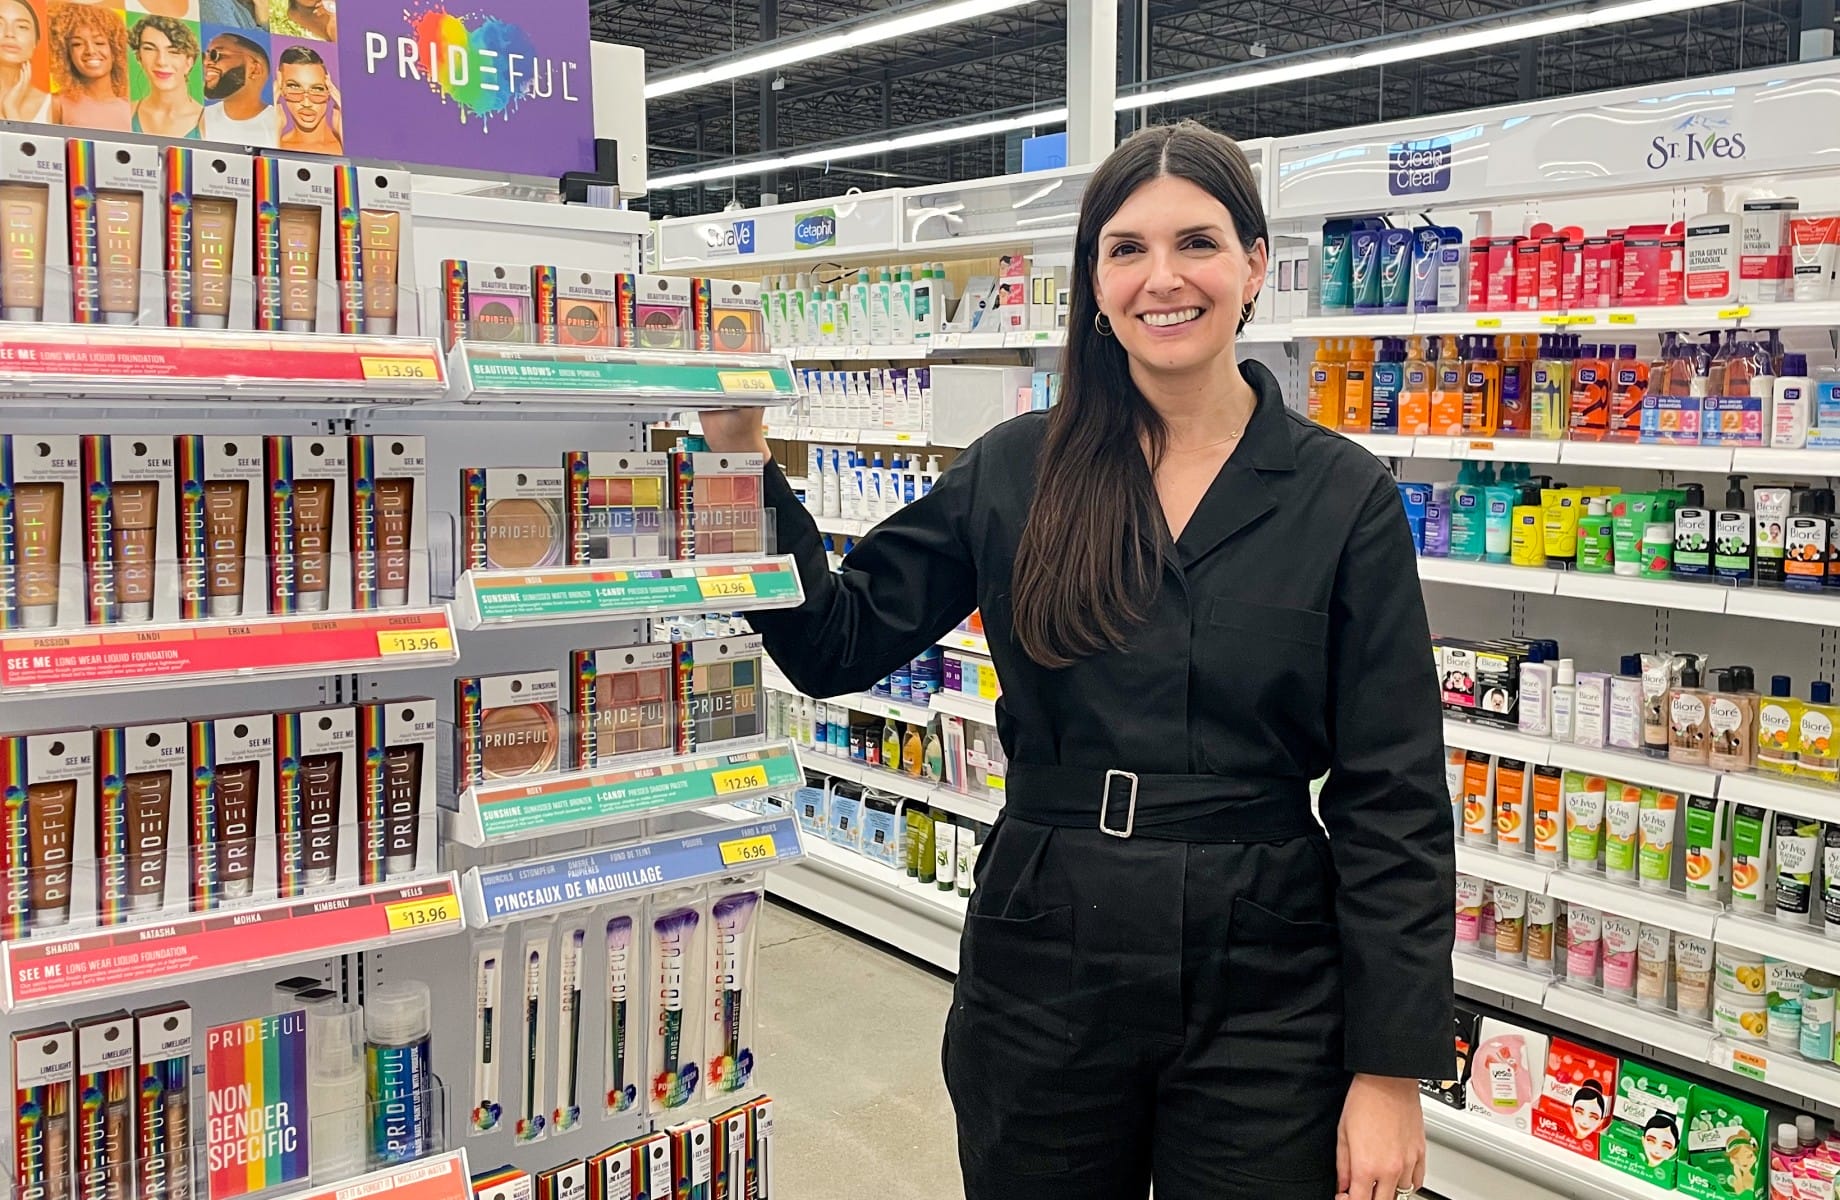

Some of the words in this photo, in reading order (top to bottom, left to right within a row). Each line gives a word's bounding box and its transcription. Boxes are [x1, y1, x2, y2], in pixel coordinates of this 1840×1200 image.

[1685, 133, 1746, 162] Ives
[1397, 150, 1442, 168] Clean
[1397, 168, 1437, 188] Clear
[797, 219, 833, 240] Cetaphil
[1689, 249, 1705, 258] ULTRA
[1707, 248, 1728, 256] GENTLE
[1689, 256, 1721, 266] ULTRADOUX
[77, 214, 99, 312] PRIDEFUL
[169, 217, 192, 316] PRIDEFUL
[259, 220, 281, 320] PRIDEFUL
[378, 362, 424, 379] $13.96
[473, 364, 519, 376] BEAUTIFUL
[52, 459, 65, 468] SEE
[67, 459, 78, 468] ME
[148, 459, 160, 467] SEE
[162, 458, 172, 467] ME
[238, 458, 250, 467] SEE
[252, 458, 261, 466] ME
[590, 511, 660, 528] PRIDEFUL
[692, 510, 757, 526] PRIDEFUL
[1678, 517, 1705, 529] Bioré
[212, 484, 236, 588] PRIDEFUL
[299, 485, 321, 584] PRIDEFUL
[382, 486, 404, 581] PRIDEFUL
[490, 525, 555, 539] PRIDEFUL
[1790, 526, 1821, 540] Bioré
[121, 489, 147, 595] PRIDEFUL
[356, 504, 376, 592] PRIDEFUL
[92, 510, 114, 607] PRIDEFUL
[184, 508, 206, 602] PRIDEFUL
[274, 506, 294, 597] PRIDEFUL
[711, 582, 746, 595] $12.96
[136, 632, 160, 641] TANDI
[228, 626, 251, 635] ERIKA
[34, 638, 70, 648] PASSION
[394, 637, 438, 651] $13.96
[8, 657, 29, 670] SEE
[33, 656, 51, 668] ME
[56, 655, 76, 666] LONG
[78, 654, 101, 665] WEAR
[104, 653, 129, 664] LIQUID
[131, 650, 178, 662] FOUNDATION
[693, 693, 757, 715] PRIDEFUL
[1673, 700, 1703, 712] Bioré
[1711, 706, 1738, 718] Bioré
[596, 703, 664, 726] PRIDEFUL
[1762, 712, 1790, 724] Bioré
[1802, 719, 1831, 732] Bioré
[249, 738, 262, 747] SEE
[262, 738, 272, 746] ME
[485, 729, 548, 748] PRIDEFUL
[161, 748, 174, 757] SEE
[175, 746, 185, 755] ME
[65, 757, 79, 766] SEE
[81, 756, 91, 765] ME
[724, 775, 758, 790] $12.96
[388, 751, 412, 849] PRIDEFUL
[597, 789, 626, 802] I-CANDY
[223, 764, 249, 873] PRIDEFUL
[309, 761, 331, 862] PRIDEFUL
[368, 772, 385, 861] PRIDEFUL
[483, 805, 522, 821] SUNSHINE
[140, 779, 162, 887] PRIDEFUL
[282, 784, 302, 874] PRIDEFUL
[41, 790, 66, 901] PRIDEFUL
[196, 792, 217, 887] PRIDEFUL
[104, 803, 126, 900] PRIDEFUL
[610, 852, 626, 862] FOND
[626, 851, 635, 860] DE
[737, 844, 766, 859] $6.96
[6, 815, 29, 914] PRIDEFUL
[400, 887, 423, 898] WELLS
[494, 884, 562, 913] PINCEAUX
[565, 881, 583, 899] DE
[587, 865, 664, 894] MAQUILLAGE
[314, 899, 350, 913] KIMBERLY
[233, 913, 262, 925] MOHKA
[403, 906, 447, 926] $13.96
[140, 927, 176, 940] NATASHA
[45, 942, 80, 955] SHARON
[19, 968, 40, 982] SEE
[44, 964, 61, 978] ME
[65, 961, 87, 974] LONG
[89, 958, 112, 970] WEAR
[114, 953, 139, 966] LIQUID
[141, 946, 188, 962] FOUNDATION
[209, 1015, 304, 1051] PRIDEFUL
[162, 1037, 191, 1050] LIMELIGHT
[102, 1047, 132, 1060] LIMELIGHT
[40, 1061, 71, 1074] LIMELIGHT
[208, 1082, 252, 1117] NON
[384, 1050, 407, 1151] PRIDEFUL
[209, 1102, 289, 1144] GENDER
[1539, 1116, 1558, 1131] yes
[209, 1126, 297, 1172] SPECIFIC
[1608, 1142, 1628, 1158] yes
[1687, 1172, 1708, 1188] yes
